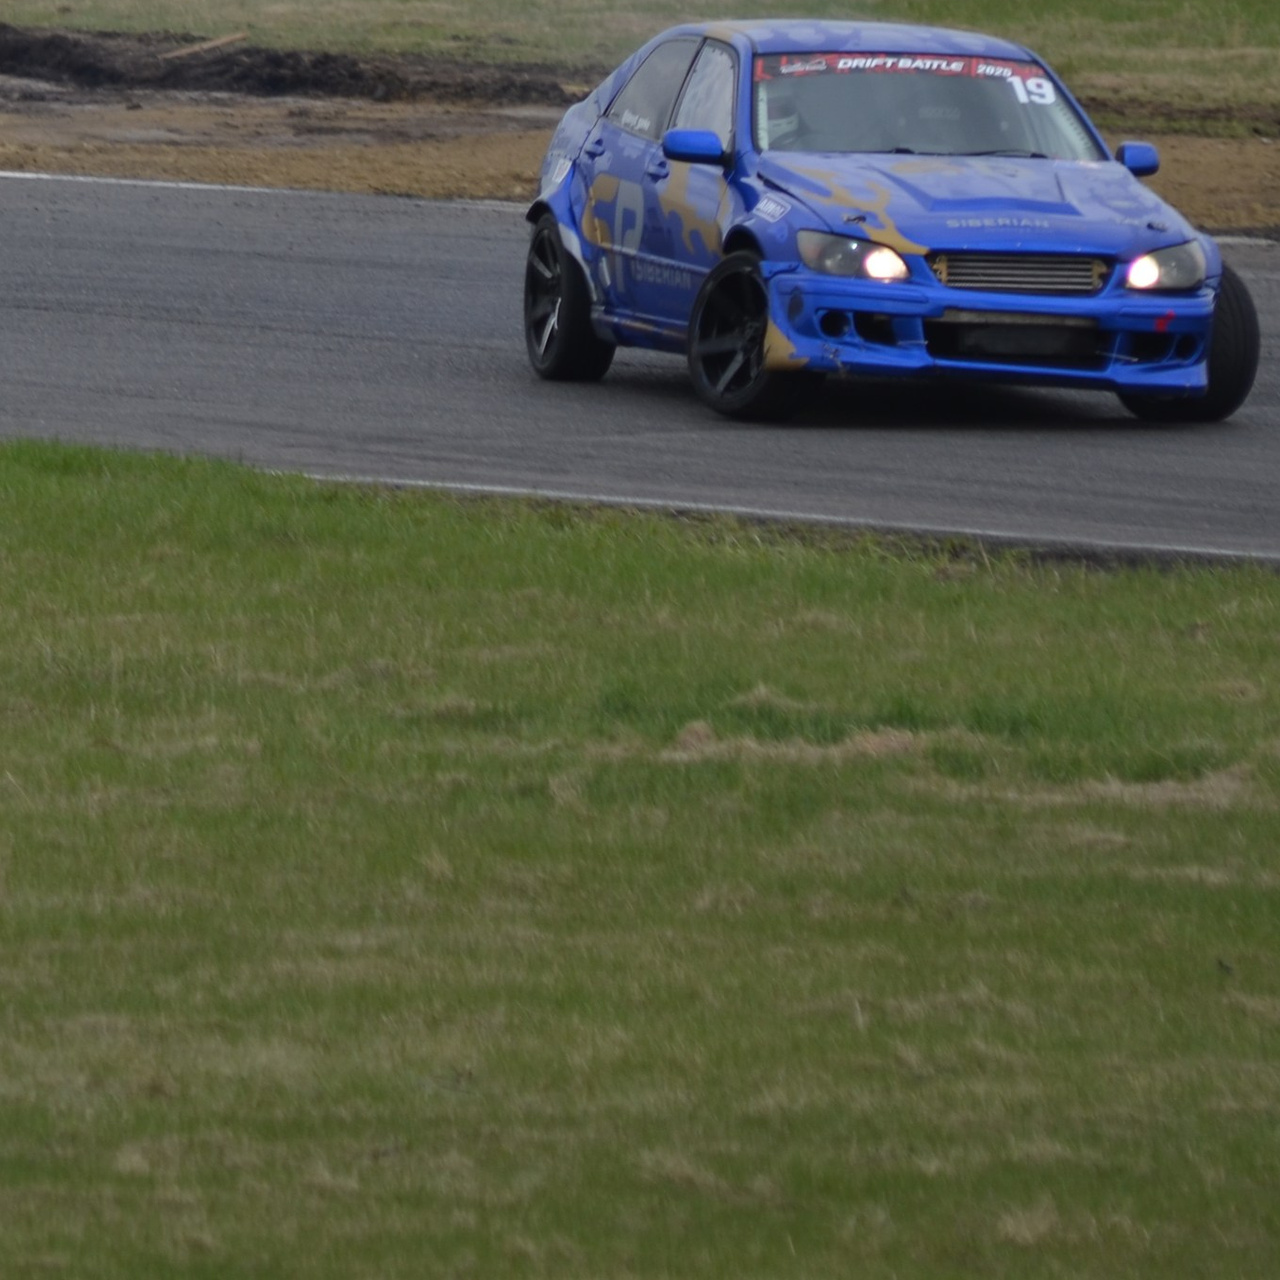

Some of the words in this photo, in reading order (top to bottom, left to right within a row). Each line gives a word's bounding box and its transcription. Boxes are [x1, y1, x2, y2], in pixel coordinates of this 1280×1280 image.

[837, 57, 899, 69] DRIFT
[898, 58, 965, 72] BATTLE
[1007, 75, 1056, 105] 19
[946, 217, 1050, 229] SIBERIAN
